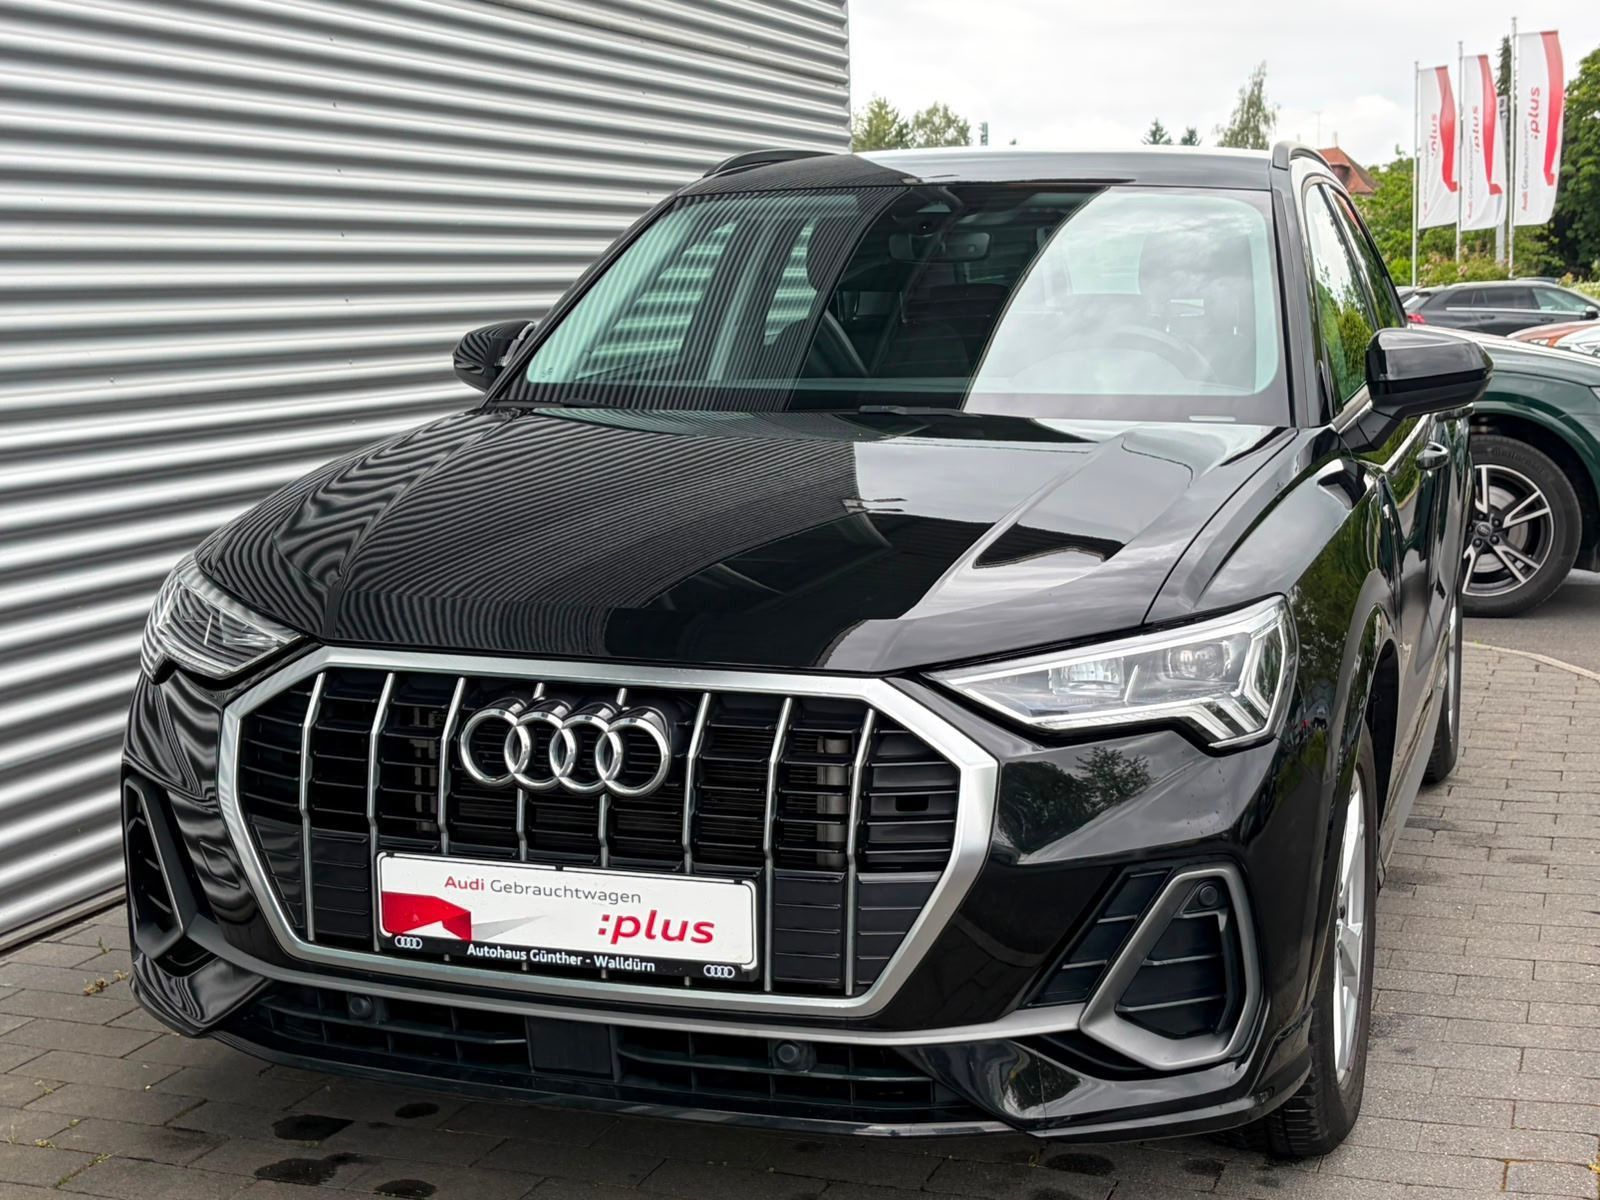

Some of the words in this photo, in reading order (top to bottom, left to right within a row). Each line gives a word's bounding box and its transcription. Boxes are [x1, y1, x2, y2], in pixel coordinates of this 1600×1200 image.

[1528, 86, 1541, 140] :plus
[444, 875, 485, 891] Audi
[490, 879, 642, 905] Gebrauchtwagen
[597, 909, 716, 945] :plus
[466, 943, 527, 961] Autohaus
[529, 948, 583, 966] Günther
[593, 955, 656, 972] Walldürn
